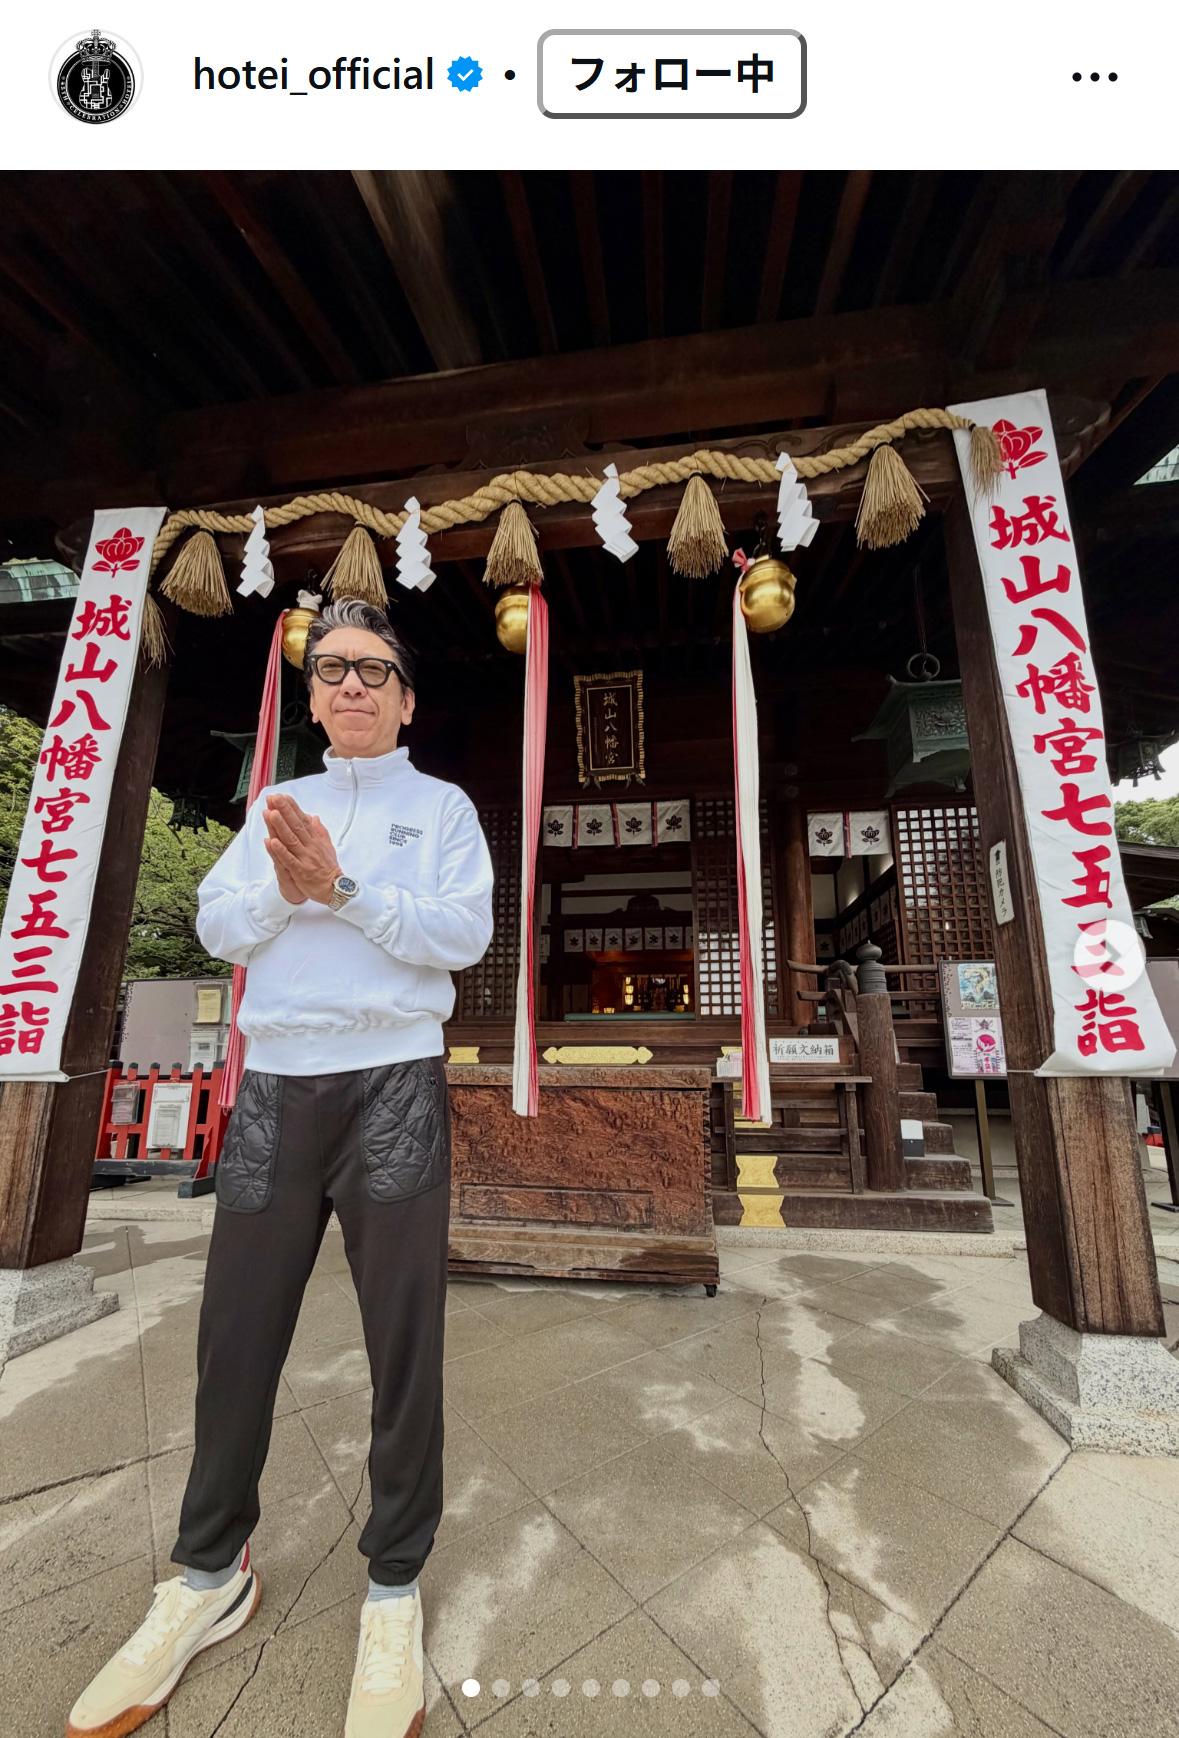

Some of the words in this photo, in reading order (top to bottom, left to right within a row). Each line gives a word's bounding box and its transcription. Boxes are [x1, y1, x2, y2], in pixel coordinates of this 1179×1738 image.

[0, 594, 132, 1054] 城山八幡宮七五三詣
[603, 691, 619, 765] 城山八幡宮
[989, 495, 1146, 1057] 城山八幡宮七五三詣
[773, 1042, 835, 1057] 祈願文納箱
